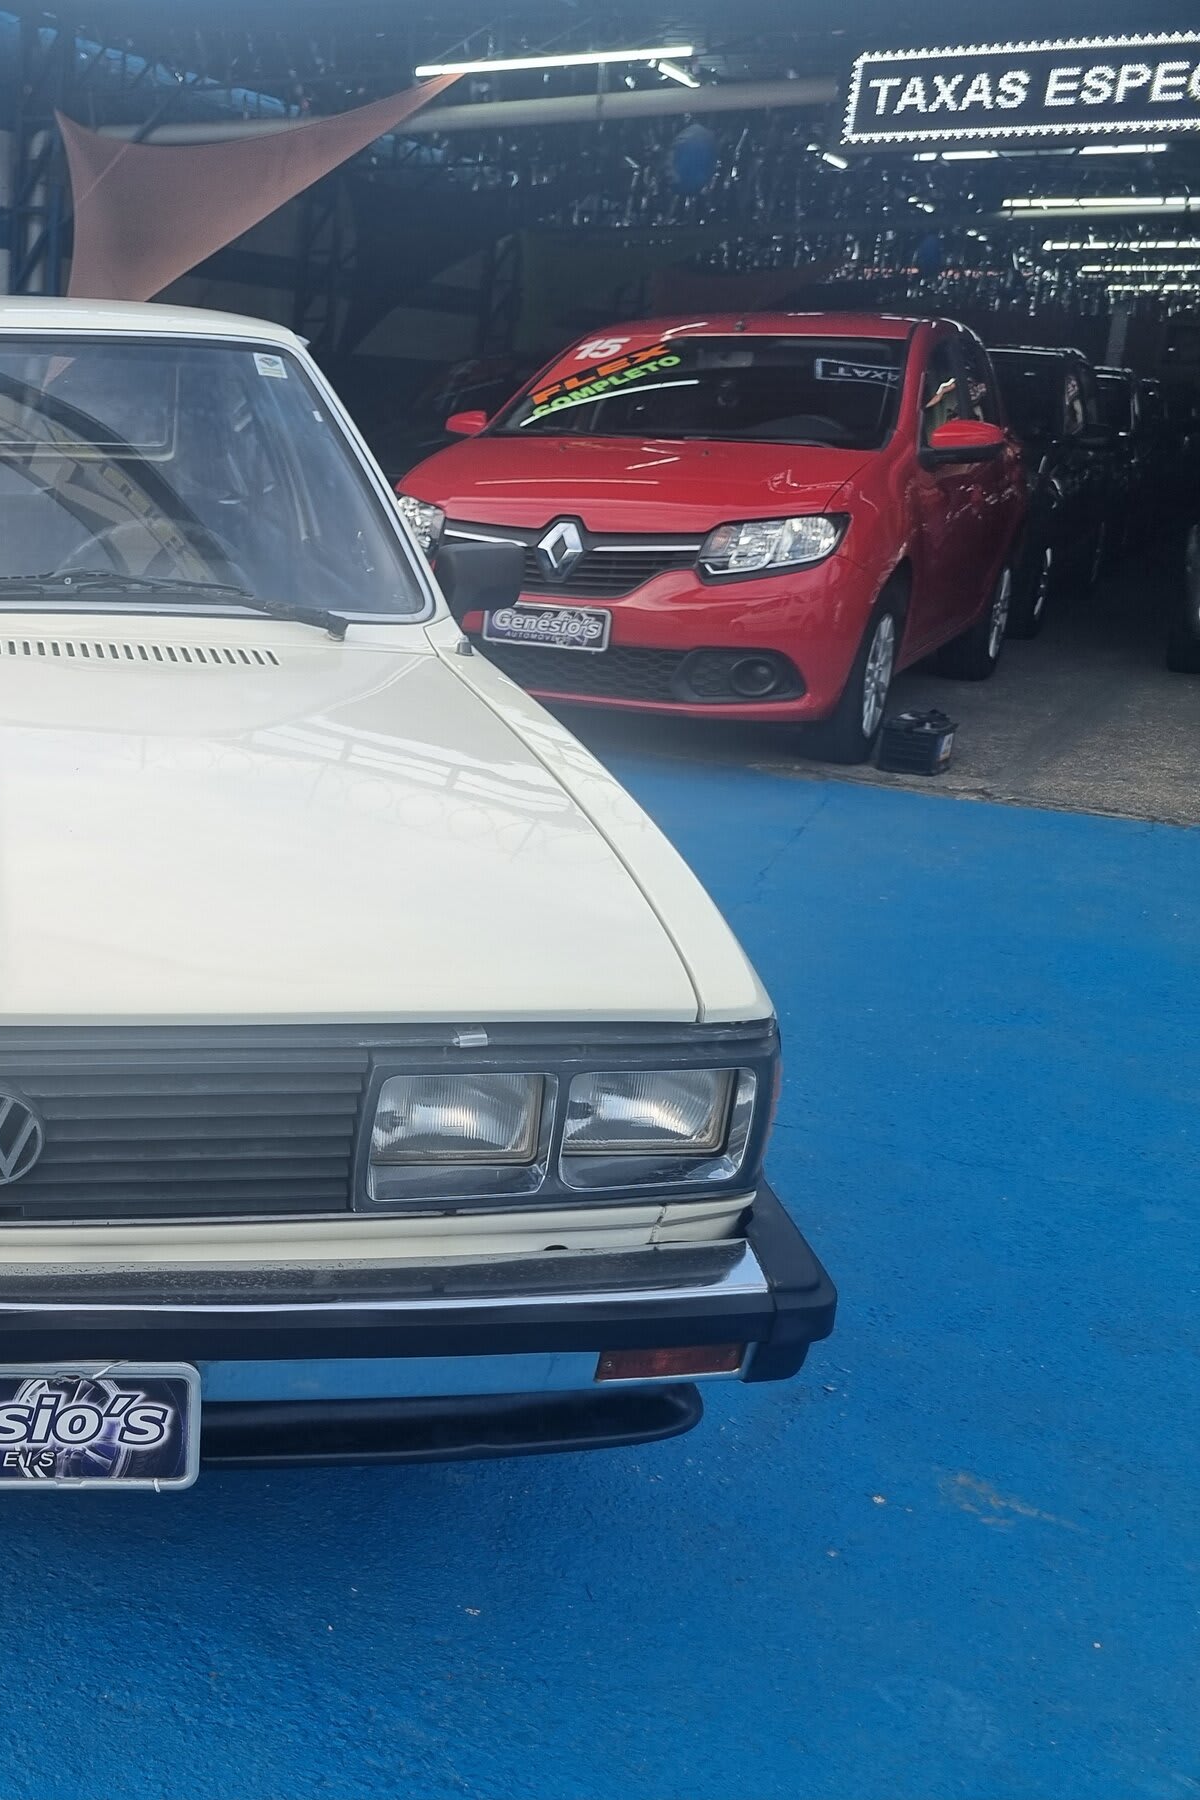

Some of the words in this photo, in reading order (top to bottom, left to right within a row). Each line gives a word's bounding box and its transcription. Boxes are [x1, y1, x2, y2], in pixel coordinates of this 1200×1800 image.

[869, 70, 1031, 115] TAXAS
[1044, 60, 1200, 108] ESPE
[532, 343, 670, 405] FLEX
[574, 337, 631, 360] 15
[532, 355, 681, 418] COMPLETO
